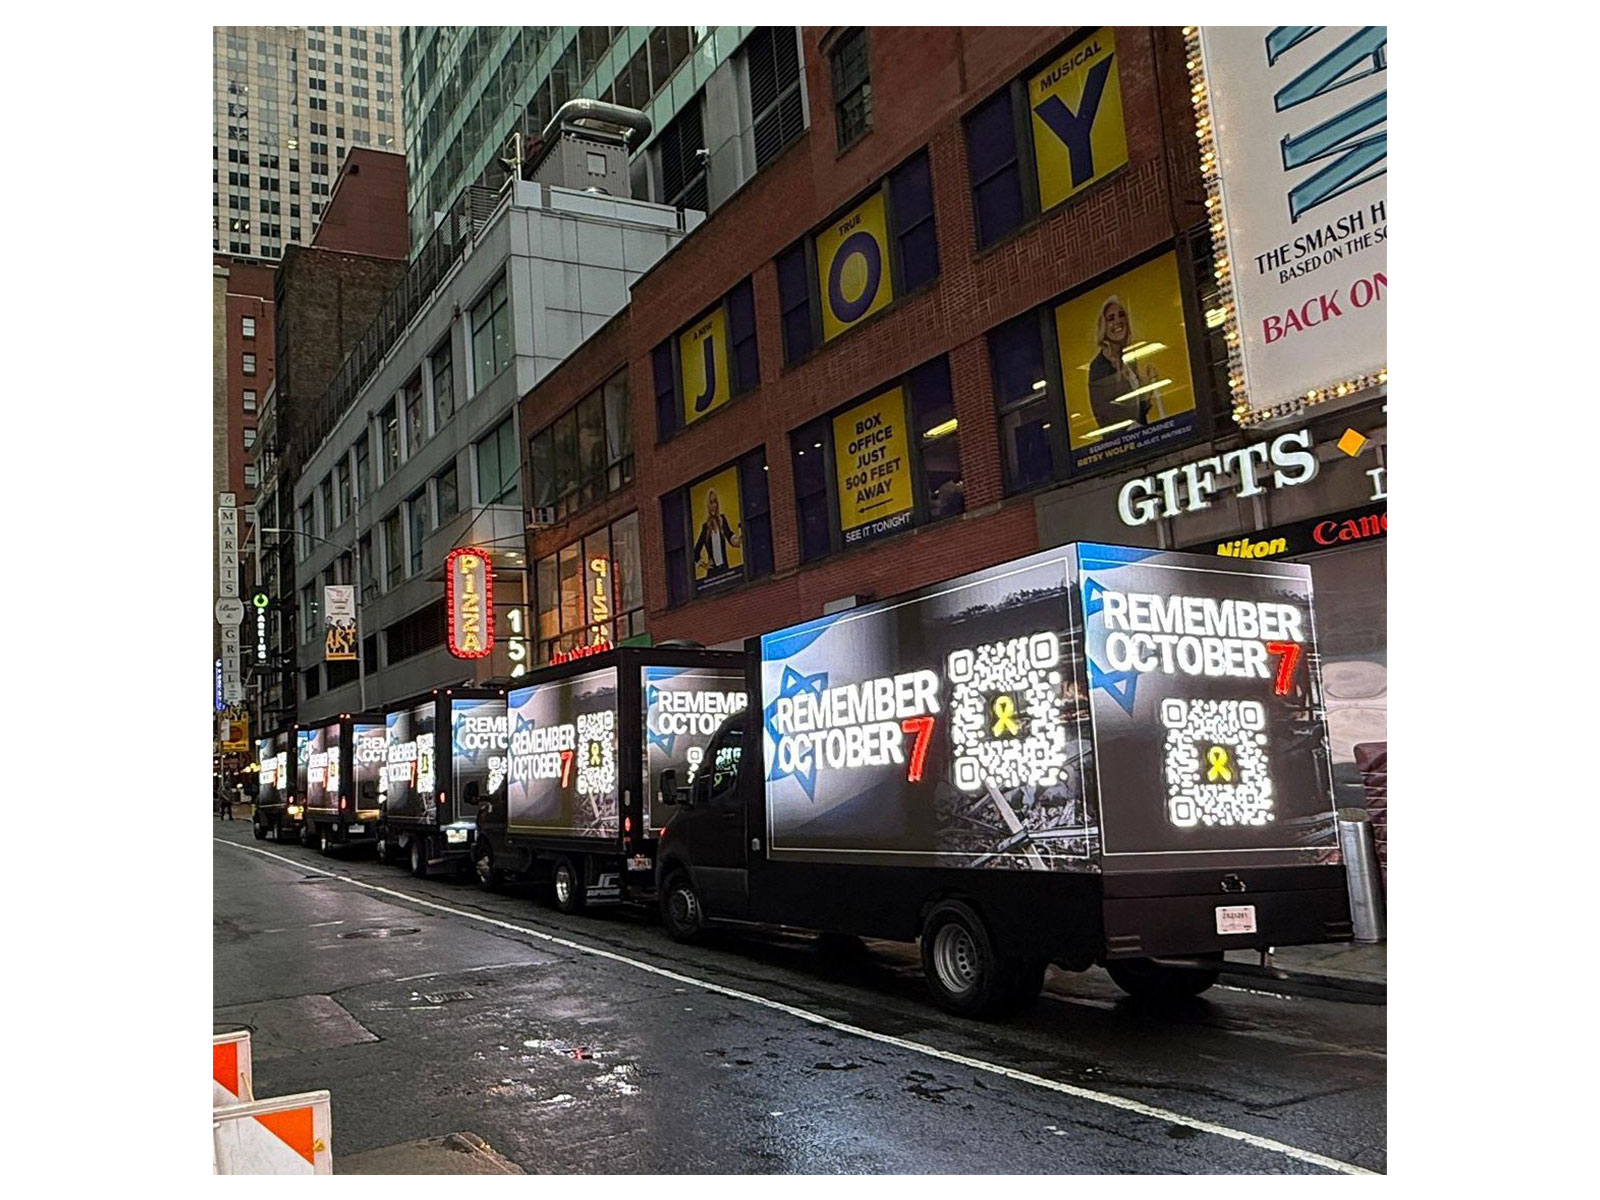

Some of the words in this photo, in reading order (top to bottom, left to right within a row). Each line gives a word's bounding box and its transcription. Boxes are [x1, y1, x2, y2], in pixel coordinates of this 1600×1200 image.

[1040, 41, 1102, 92] MUSICAL
[1033, 52, 1114, 189] Y
[838, 213, 862, 236] TRUE
[1255, 243, 1291, 275] THE
[1294, 210, 1364, 259] SMASH
[828, 231, 882, 324] O
[1279, 256, 1321, 284] BASED
[1323, 246, 1343, 265] ON
[1346, 232, 1372, 255] THE
[1262, 289, 1343, 344] BACK
[695, 334, 716, 412] J
[848, 425, 893, 455] OFFICE
[855, 413, 882, 435] BOX
[846, 471, 868, 490] 500
[870, 457, 901, 480] FEET
[857, 446, 886, 469] JUST
[1077, 453, 1104, 468] BETSY
[1105, 442, 1137, 458] WOLFE
[1118, 429, 1316, 526] GIFTS
[856, 478, 892, 504] AWAY
[222, 511, 234, 594] MARAIS
[846, 529, 861, 543] SEE
[863, 525, 870, 537] IT
[872, 512, 911, 534] TONIGHT
[1217, 537, 1287, 558] Nikon
[460, 555, 481, 652] PIZZA
[1101, 590, 1304, 642] REMEMBER
[1105, 632, 1271, 679] OCTOBER
[1266, 641, 1300, 696] 7
[776, 669, 941, 734] REMEMBER
[513, 724, 576, 753] REMEMBER
[778, 721, 904, 775] OCTOBER
[902, 716, 935, 782] 7
[513, 751, 562, 779] OCTOBER
[561, 750, 574, 788] 7
